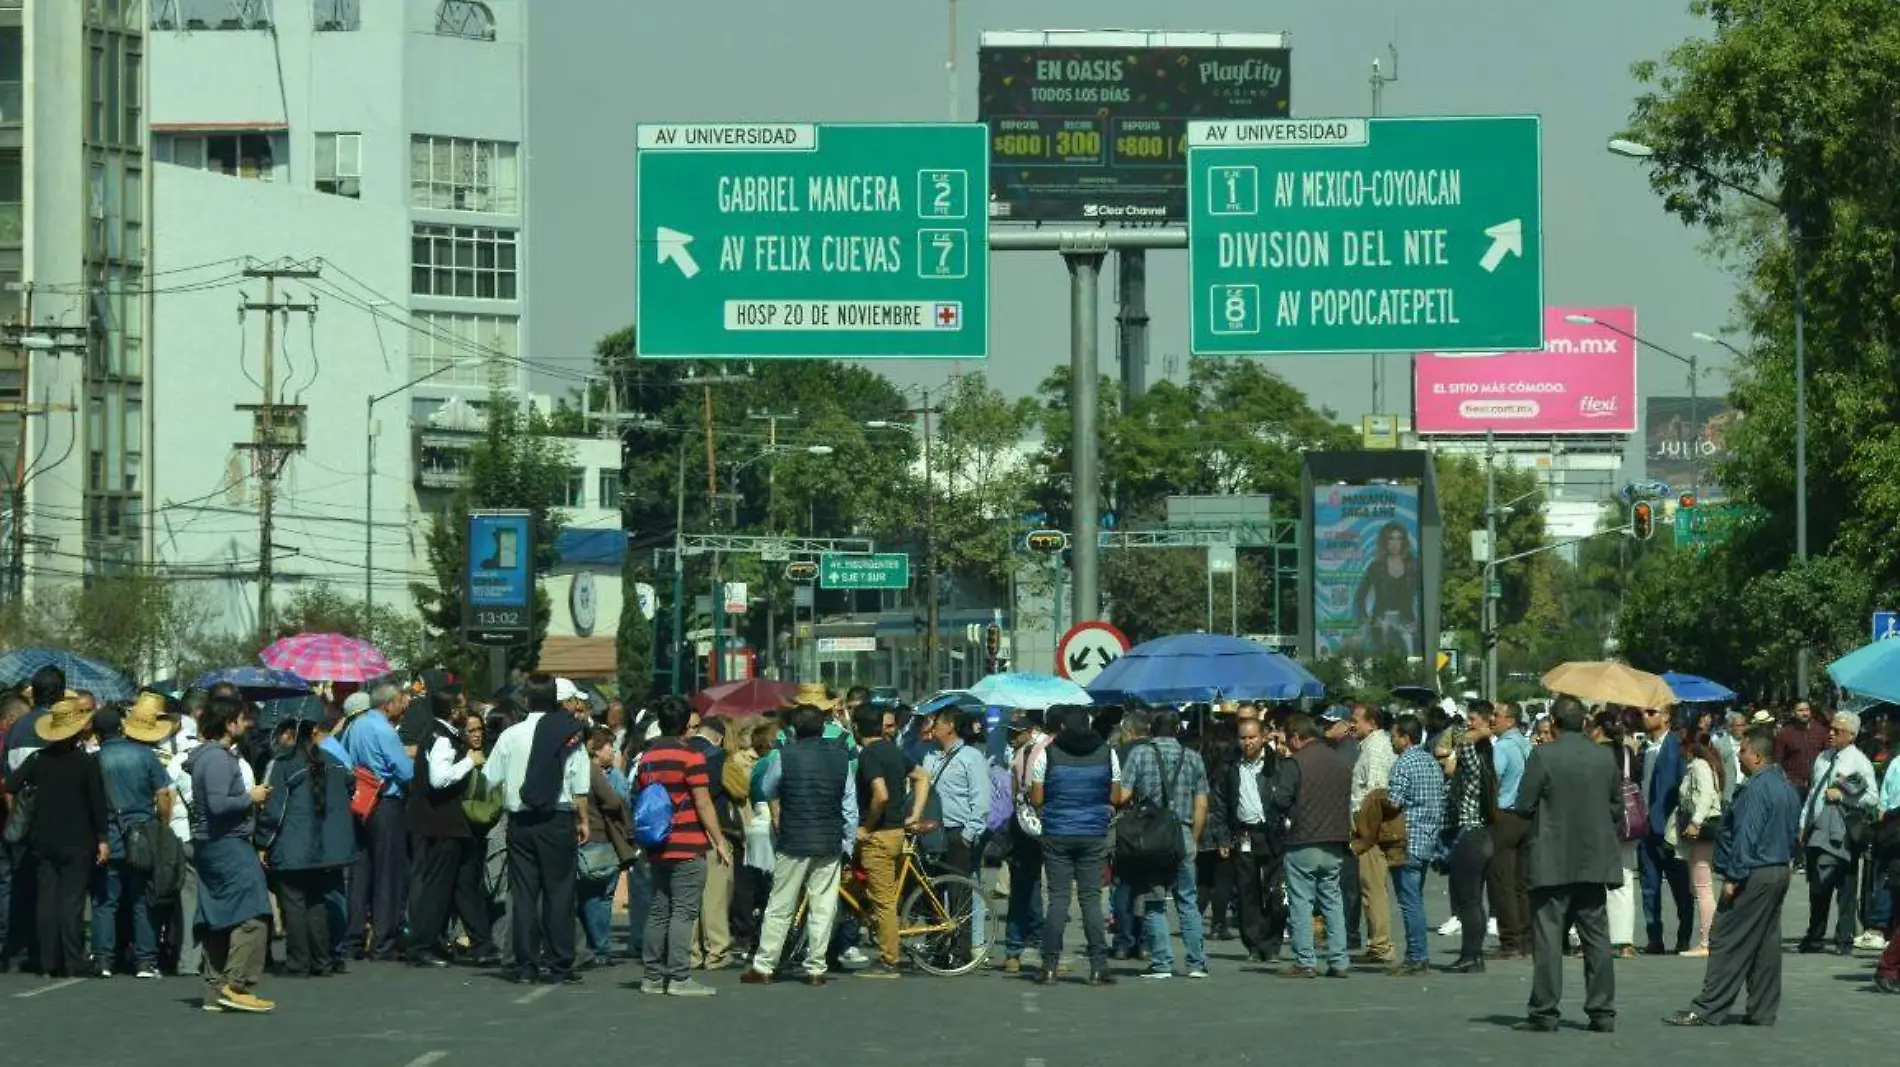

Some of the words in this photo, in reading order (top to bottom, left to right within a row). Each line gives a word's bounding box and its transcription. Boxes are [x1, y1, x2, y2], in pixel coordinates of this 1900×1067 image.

[1036, 60, 1062, 81] EN
[1066, 60, 1124, 81] OASIS
[1199, 58, 1282, 88] PlayCity
[1032, 87, 1073, 101] TODOS
[1076, 87, 1099, 101] LOS
[1101, 84, 1130, 101] DÍAS
[655, 128, 677, 144] AV
[685, 128, 797, 145] UNIVERSIDAD
[1056, 131, 1100, 154] 300
[1206, 126, 1227, 141] AV
[1236, 124, 1348, 141] UNIVERSIDAD
[718, 176, 800, 213] GABRIEL
[808, 175, 901, 213] MANCERA
[934, 182, 951, 207] 2
[1226, 178, 1236, 203] 1
[1274, 172, 1294, 207] AV
[1302, 169, 1462, 207] MEXICO-COYOACAN
[1099, 205, 1122, 216] Clear
[1126, 204, 1166, 216] Channel
[720, 236, 744, 271] AV
[755, 236, 810, 271] FELIX
[821, 236, 901, 272] CUEVAS
[932, 241, 953, 267] 7
[1219, 232, 1329, 268] DIVISION
[1344, 231, 1391, 267] DEL
[1404, 229, 1449, 266] NTE
[737, 305, 777, 325] HOSP
[783, 305, 801, 325] 20
[811, 305, 830, 325] DE
[837, 305, 922, 325] NOVIEMBRE
[1225, 297, 1245, 321] 8
[1276, 290, 1300, 327] AV
[1310, 288, 1459, 326] POPOCATEPETL
[1433, 384, 1445, 394] EL
[1448, 383, 1479, 394] SITIO
[1481, 381, 1505, 394] MÁS
[1656, 440, 1717, 457] JULIO
[868, 572, 887, 582] SUR
[477, 611, 519, 625] 13:02
